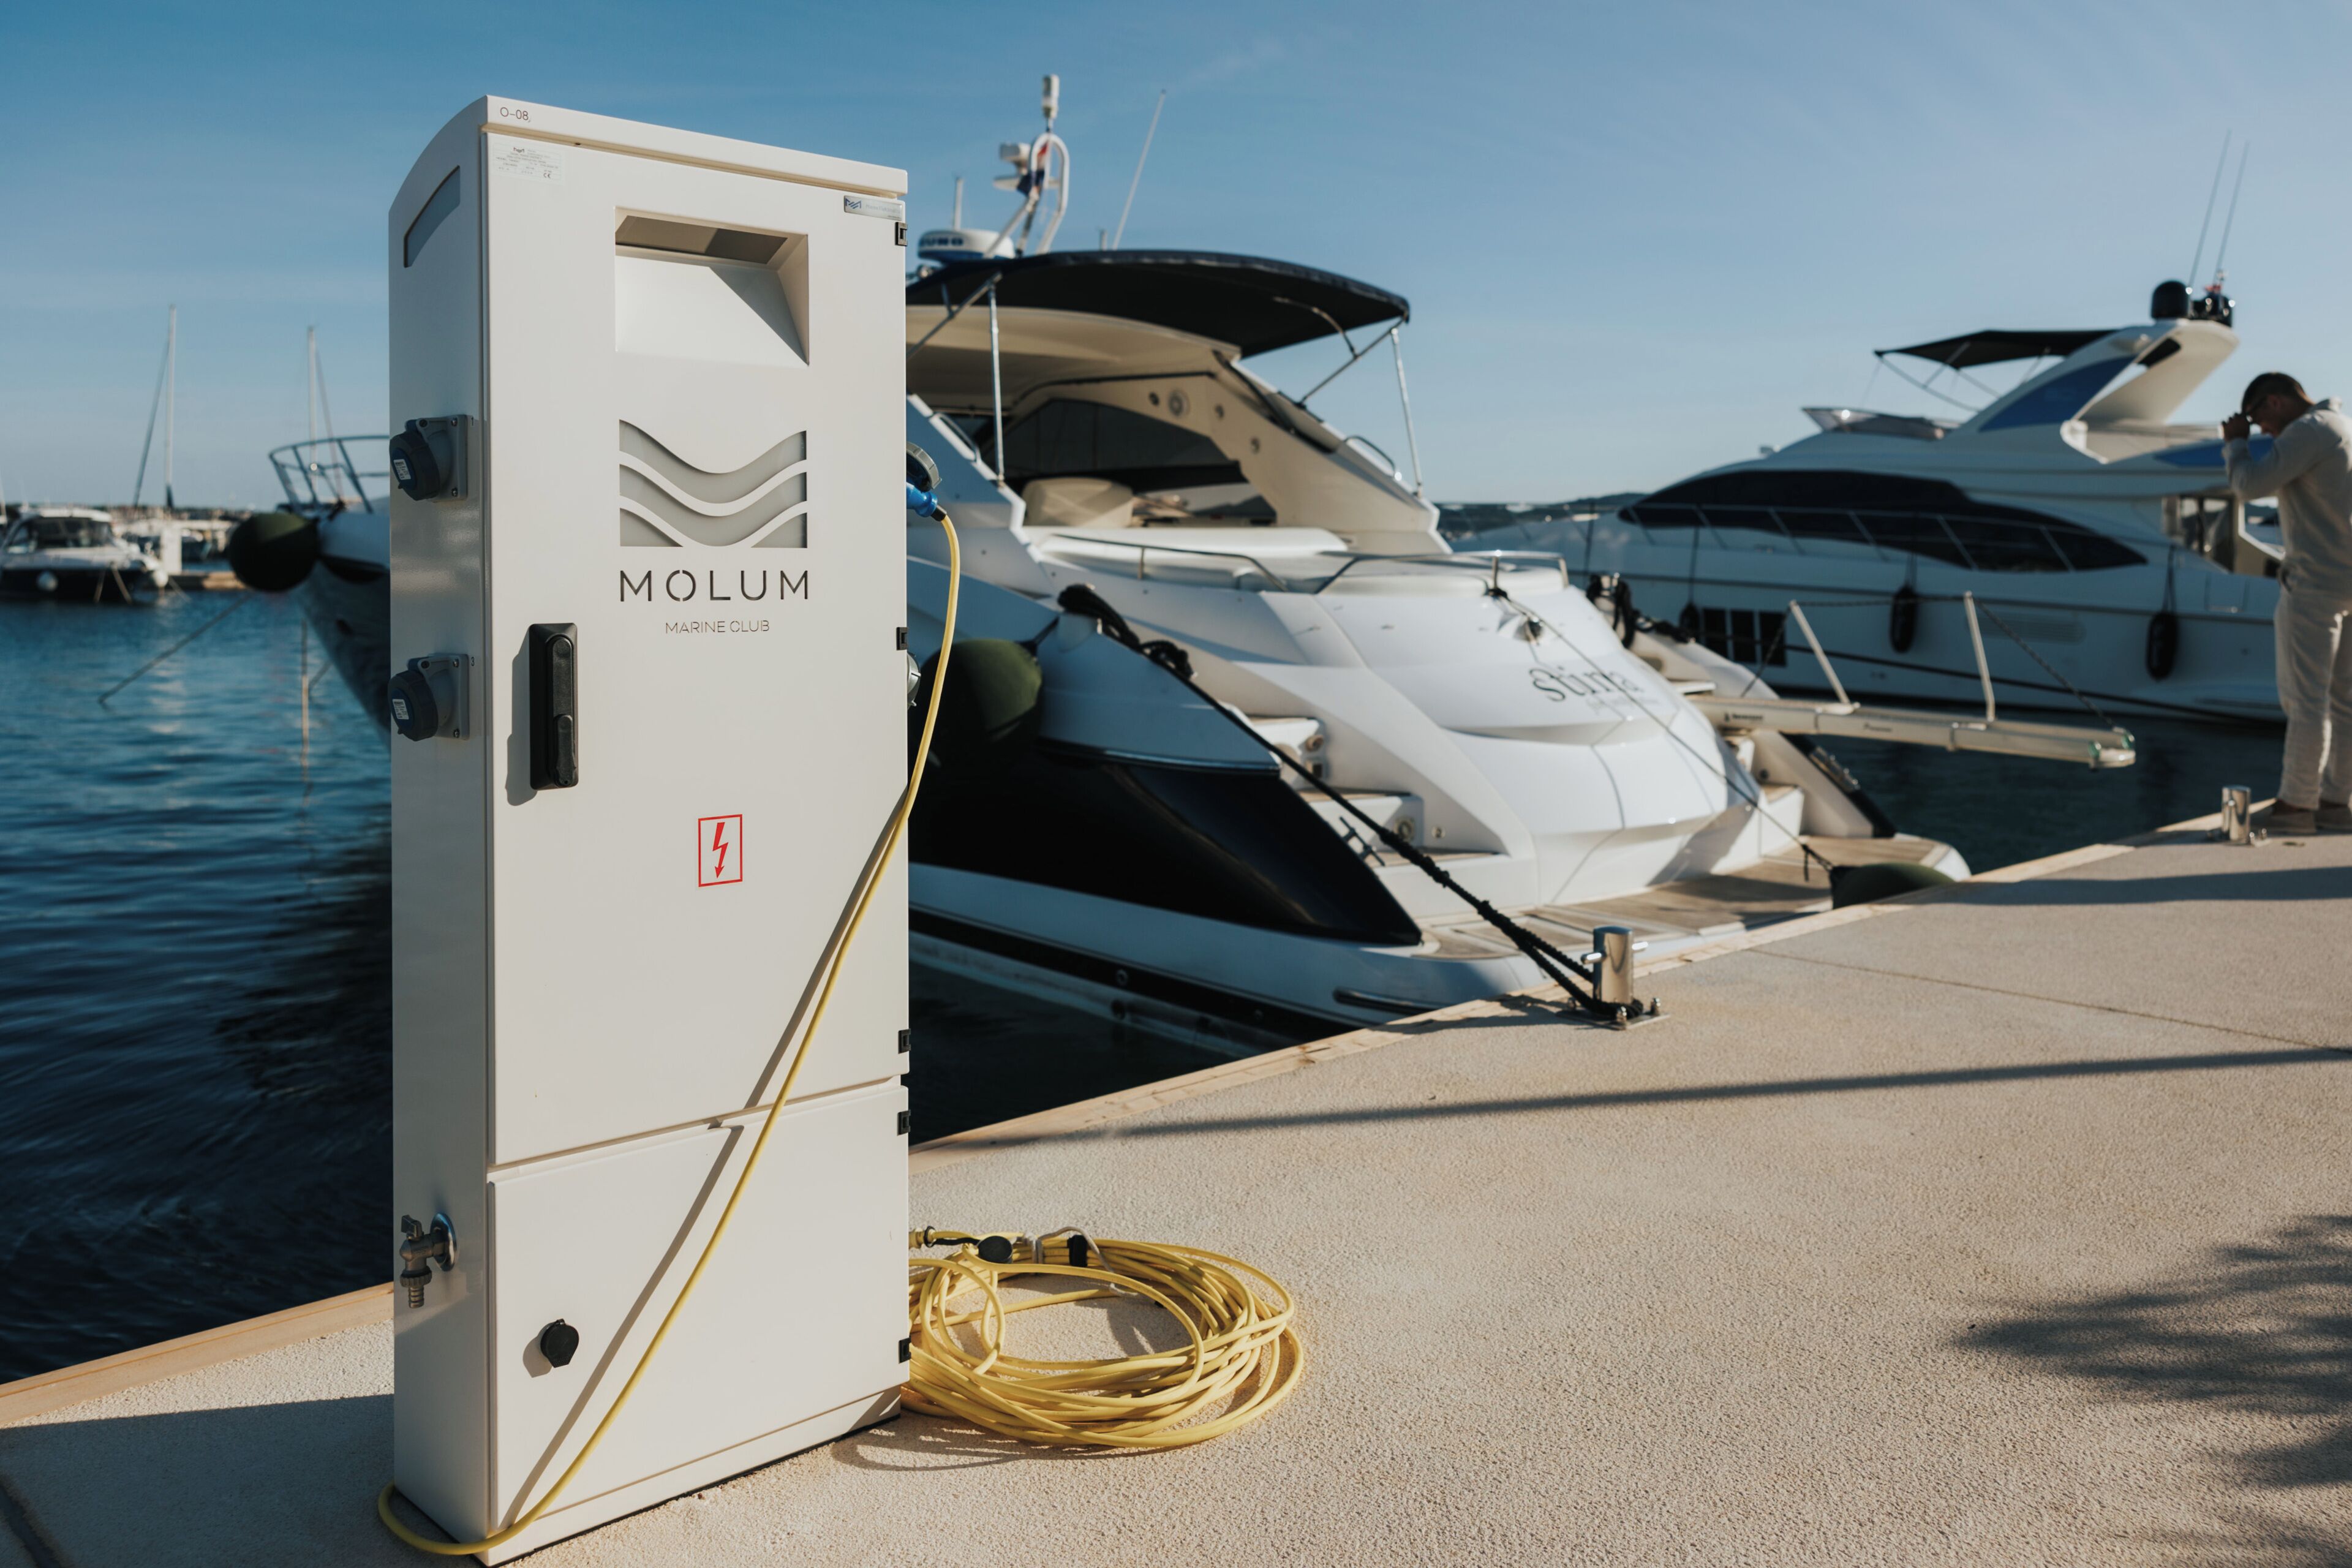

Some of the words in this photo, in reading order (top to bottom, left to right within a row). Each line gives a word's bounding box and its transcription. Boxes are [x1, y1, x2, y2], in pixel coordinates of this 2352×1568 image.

[500, 107, 529, 121] O-08
[471, 416, 474, 426] 1
[620, 570, 808, 601] MOLUM
[665, 621, 726, 634] MARINE
[729, 620, 770, 633] CLUB
